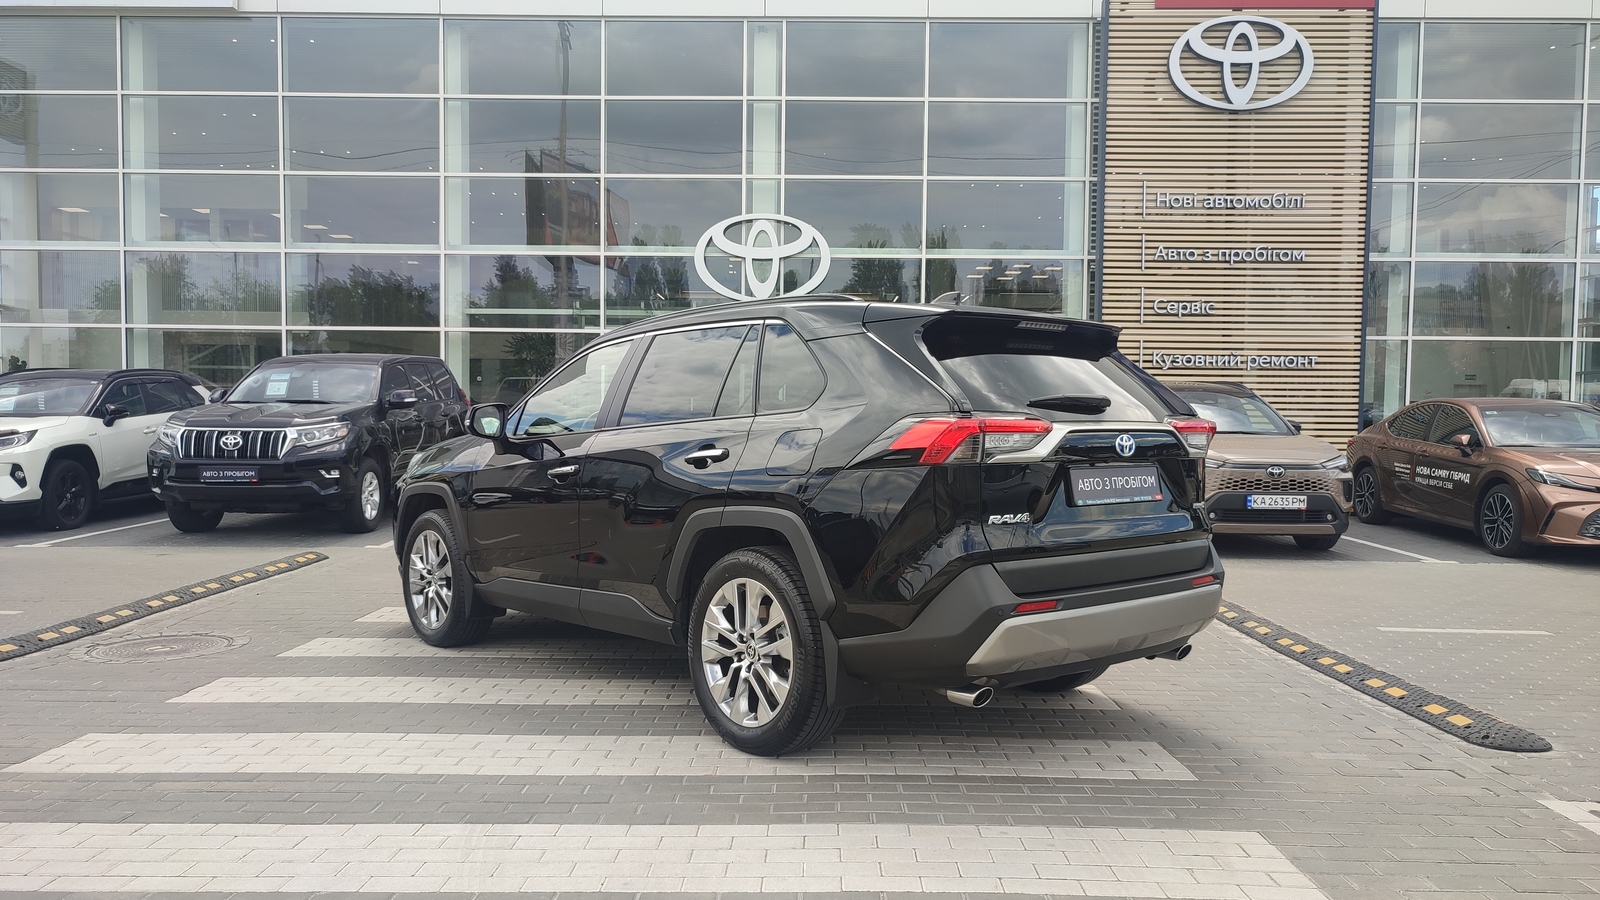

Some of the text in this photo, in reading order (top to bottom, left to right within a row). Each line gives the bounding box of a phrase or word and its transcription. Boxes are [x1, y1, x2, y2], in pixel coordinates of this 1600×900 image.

[1155, 191, 1307, 209] Нові автомобілі
[1154, 245, 1306, 265] Авто з пробігом
[1153, 298, 1216, 318] Сервіс
[1152, 351, 1318, 371] Кузовний ремонт
[1415, 465, 1431, 476] НОВА
[1078, 478, 1103, 491] АВТО
[1111, 475, 1156, 489] ПРОБІГОМ
[1268, 497, 1290, 506] 2635
[988, 512, 1030, 525] RAV4
